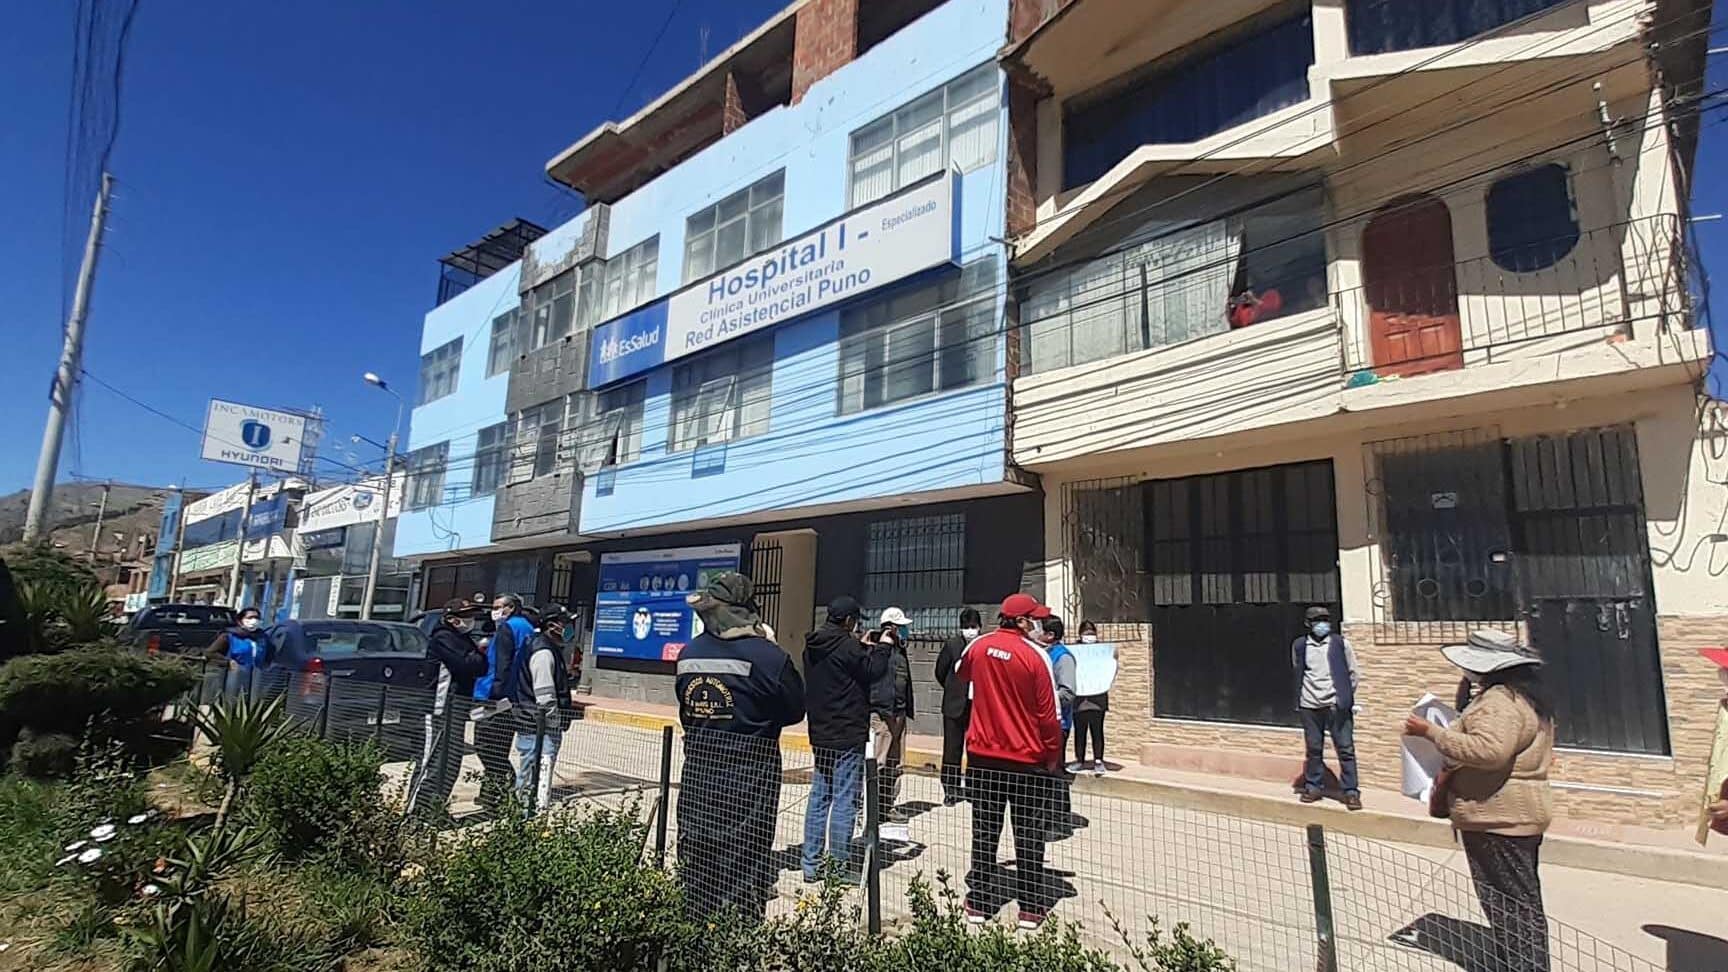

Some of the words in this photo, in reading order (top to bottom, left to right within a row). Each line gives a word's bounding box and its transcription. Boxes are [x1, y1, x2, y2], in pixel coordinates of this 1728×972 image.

[708, 231, 826, 305] Hospital
[881, 200, 937, 232] Especializado
[748, 259, 845, 306] Universitaria
[685, 323, 714, 349] Red
[717, 285, 811, 337] Asistencial
[818, 268, 871, 300] Puno
[619, 324, 660, 356] EsSalud
[221, 450, 283, 467] HYUNDAI
[986, 647, 1012, 660] PERU
